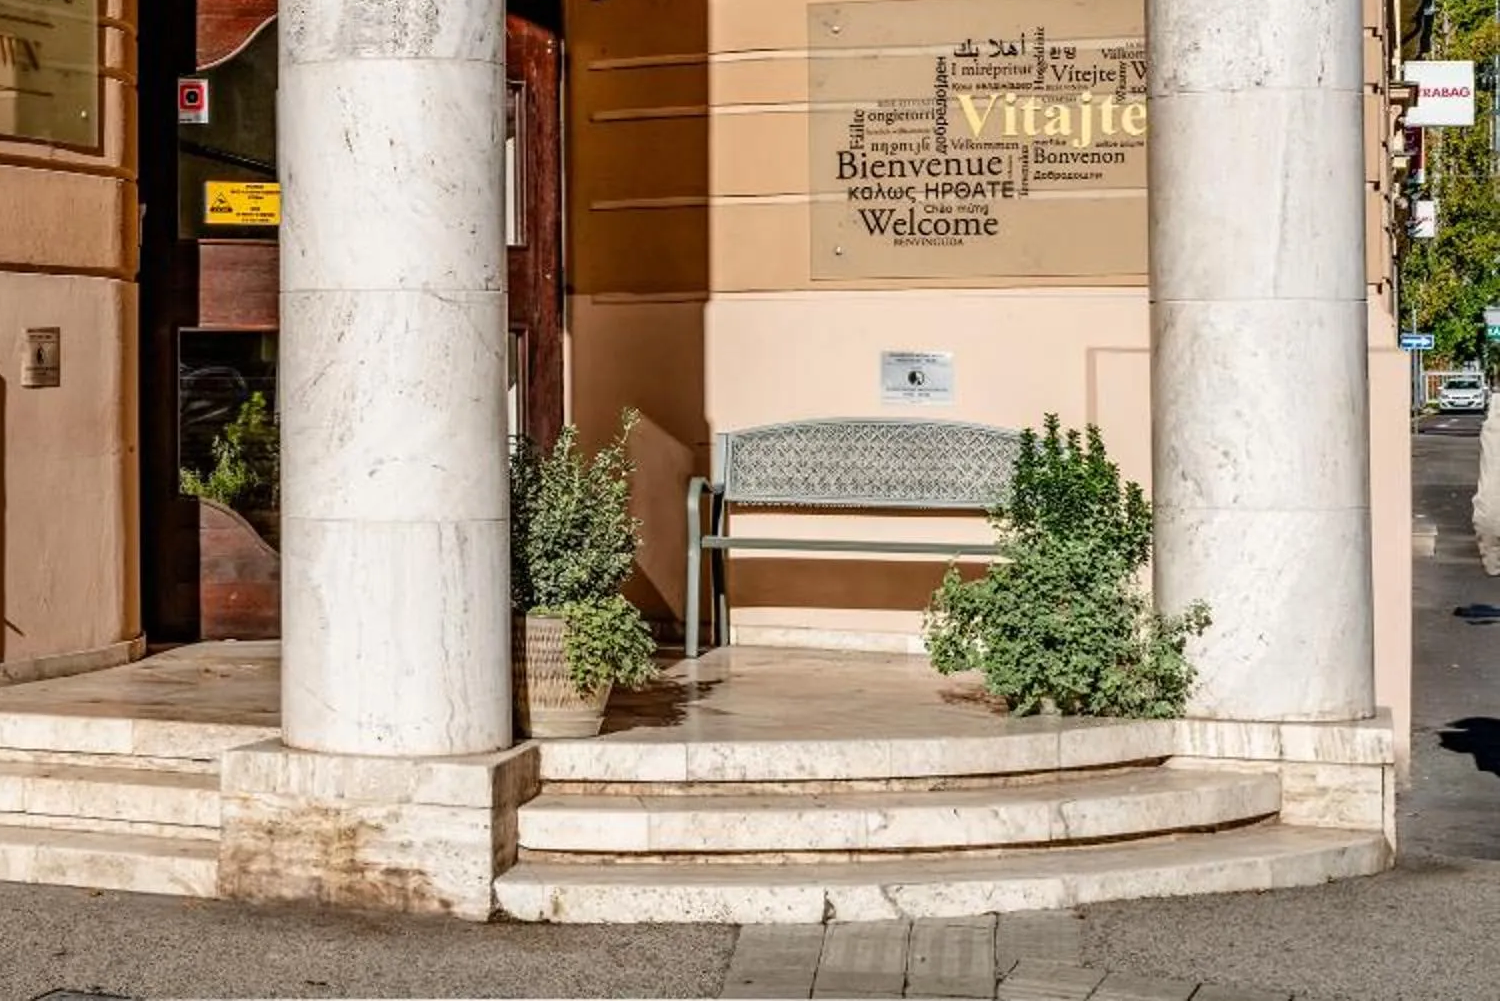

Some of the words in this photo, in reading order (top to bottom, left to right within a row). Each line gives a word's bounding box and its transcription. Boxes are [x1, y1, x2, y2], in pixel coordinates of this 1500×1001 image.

[1050, 64, 1117, 87] Vítejte
[957, 91, 1148, 148] Vitajte
[836, 150, 1003, 180] Bienvenue
[1033, 146, 1126, 164] Bonvenon
[858, 207, 999, 237] Welcome
